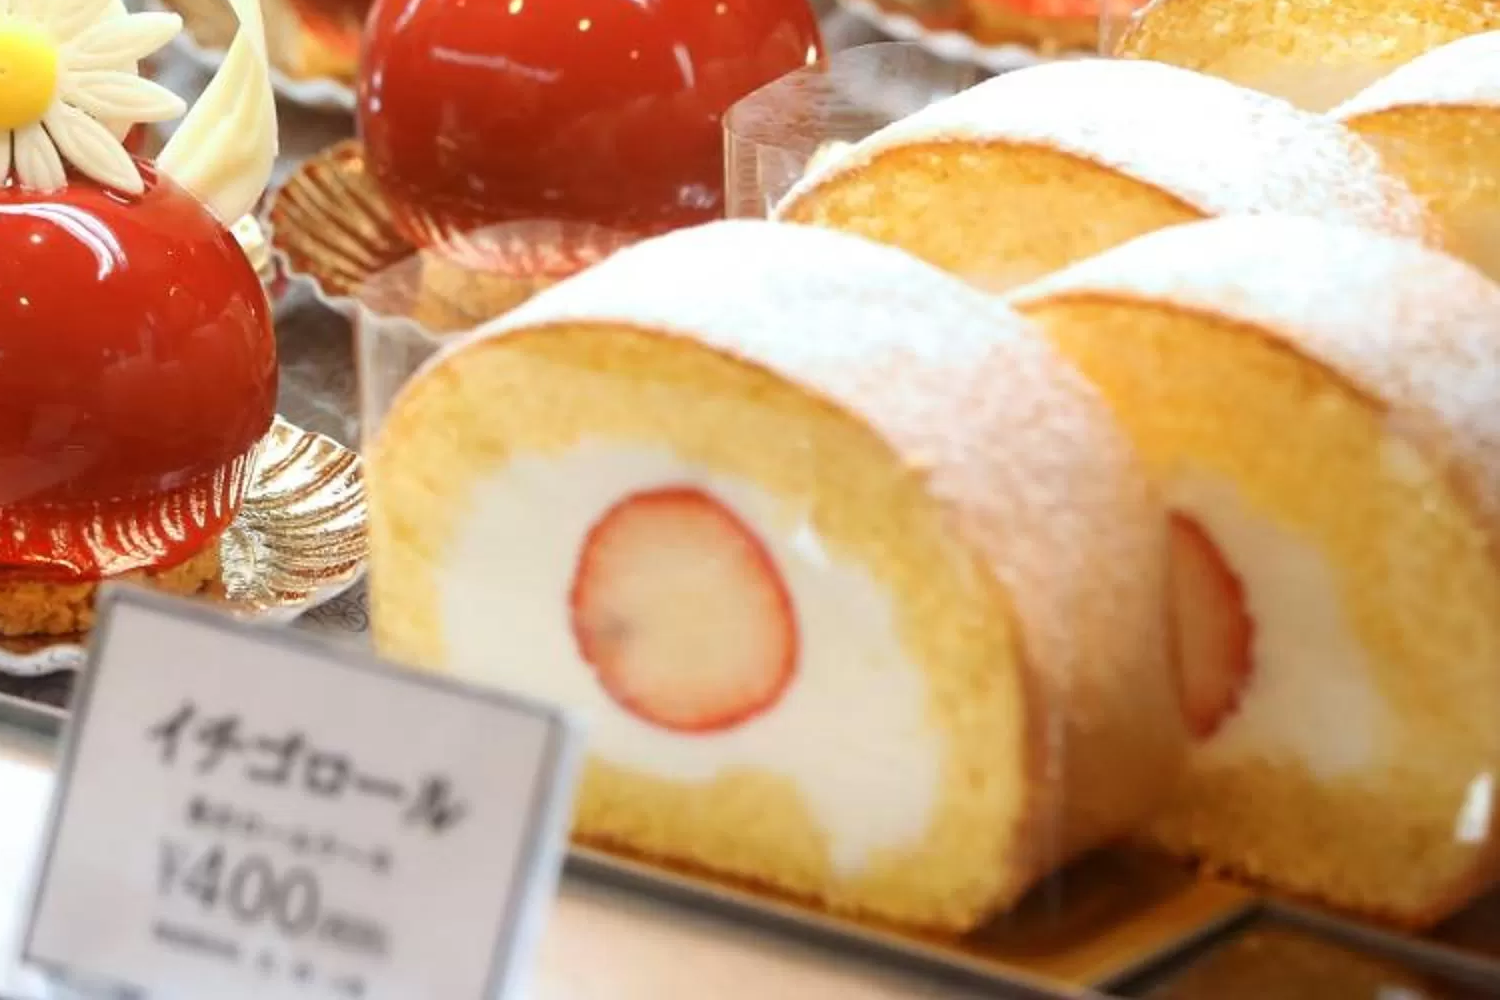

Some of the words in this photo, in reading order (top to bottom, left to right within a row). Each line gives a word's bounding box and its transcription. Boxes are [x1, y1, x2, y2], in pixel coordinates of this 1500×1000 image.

[148, 700, 469, 836] イチゴロール
